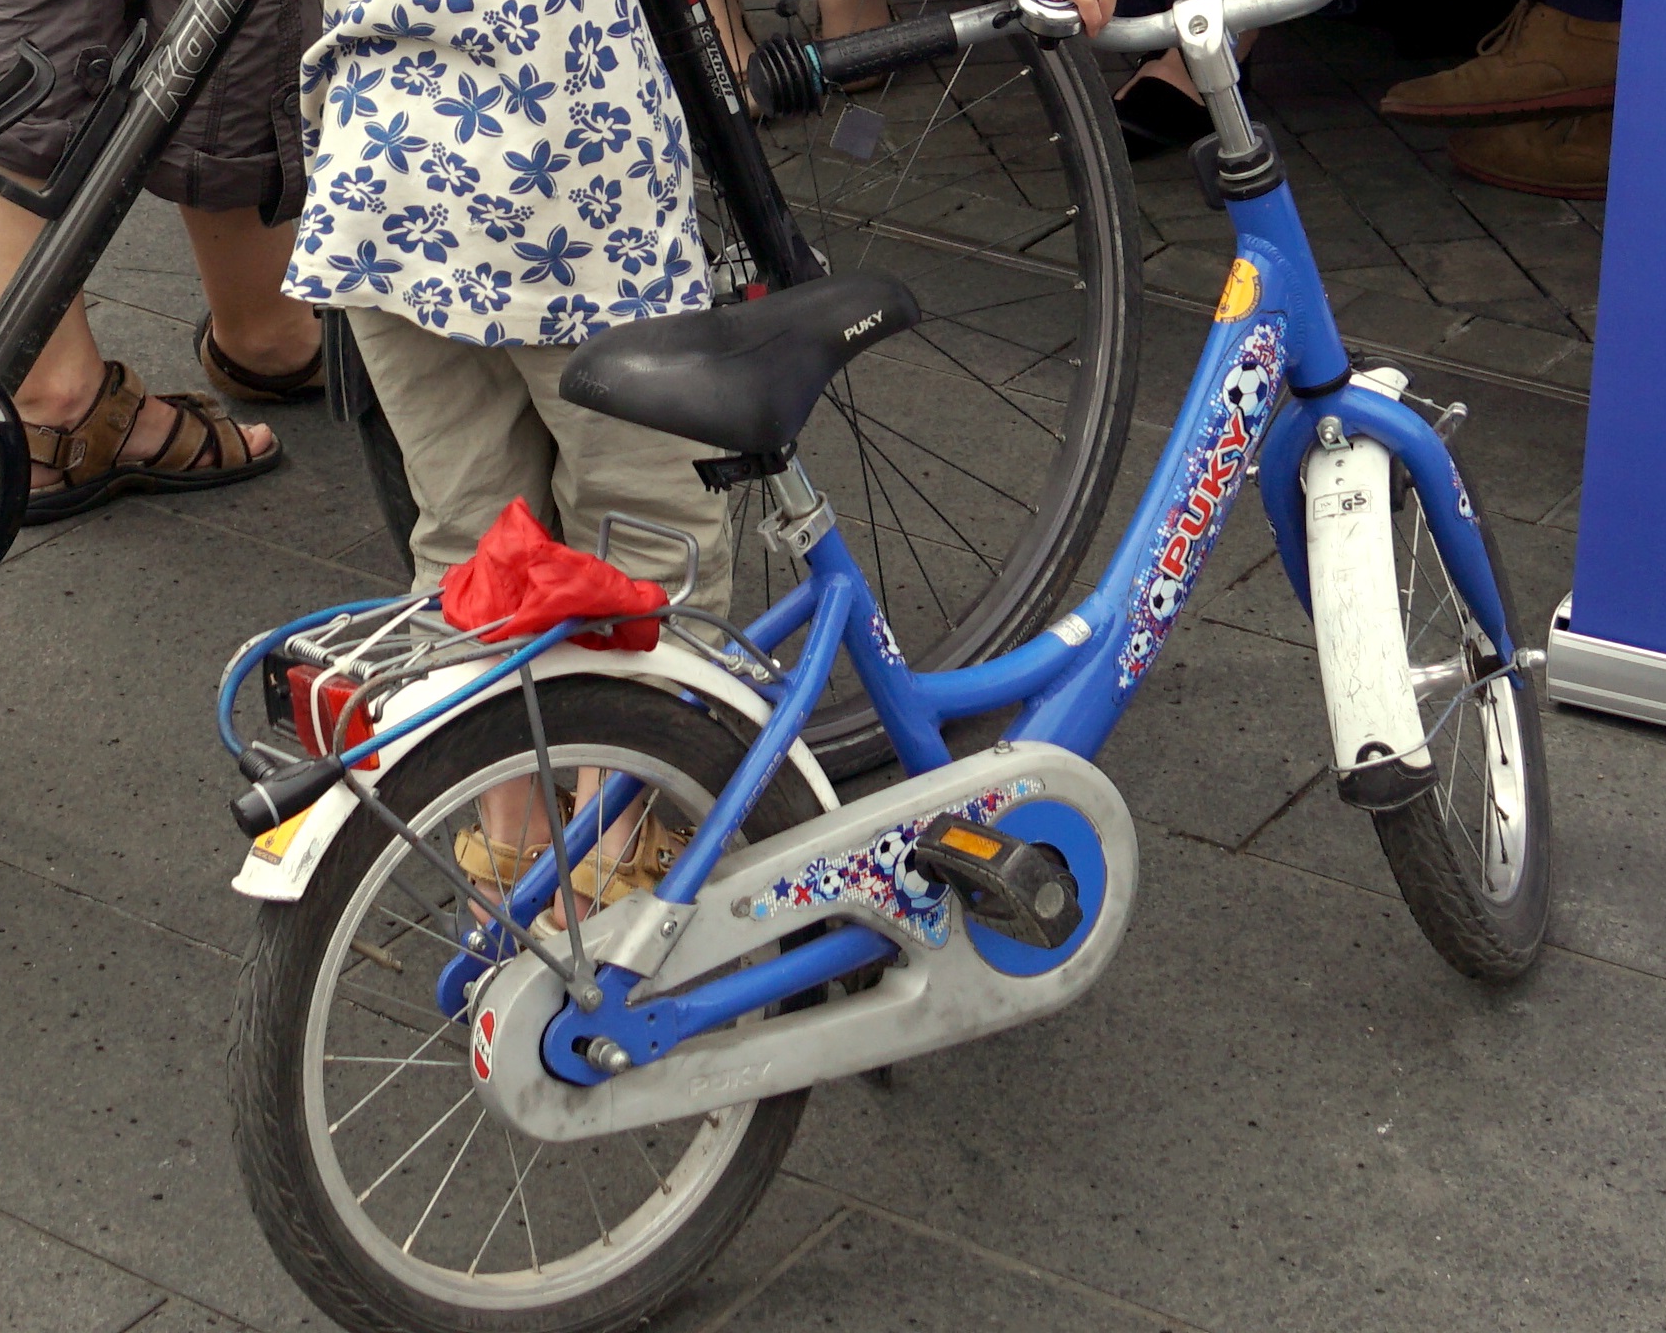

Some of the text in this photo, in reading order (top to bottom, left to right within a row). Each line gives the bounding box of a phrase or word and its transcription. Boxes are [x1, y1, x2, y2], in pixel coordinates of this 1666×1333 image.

[843, 310, 884, 342] PUKY
[1159, 410, 1252, 579] PUKY
[1342, 491, 1367, 511] GS
